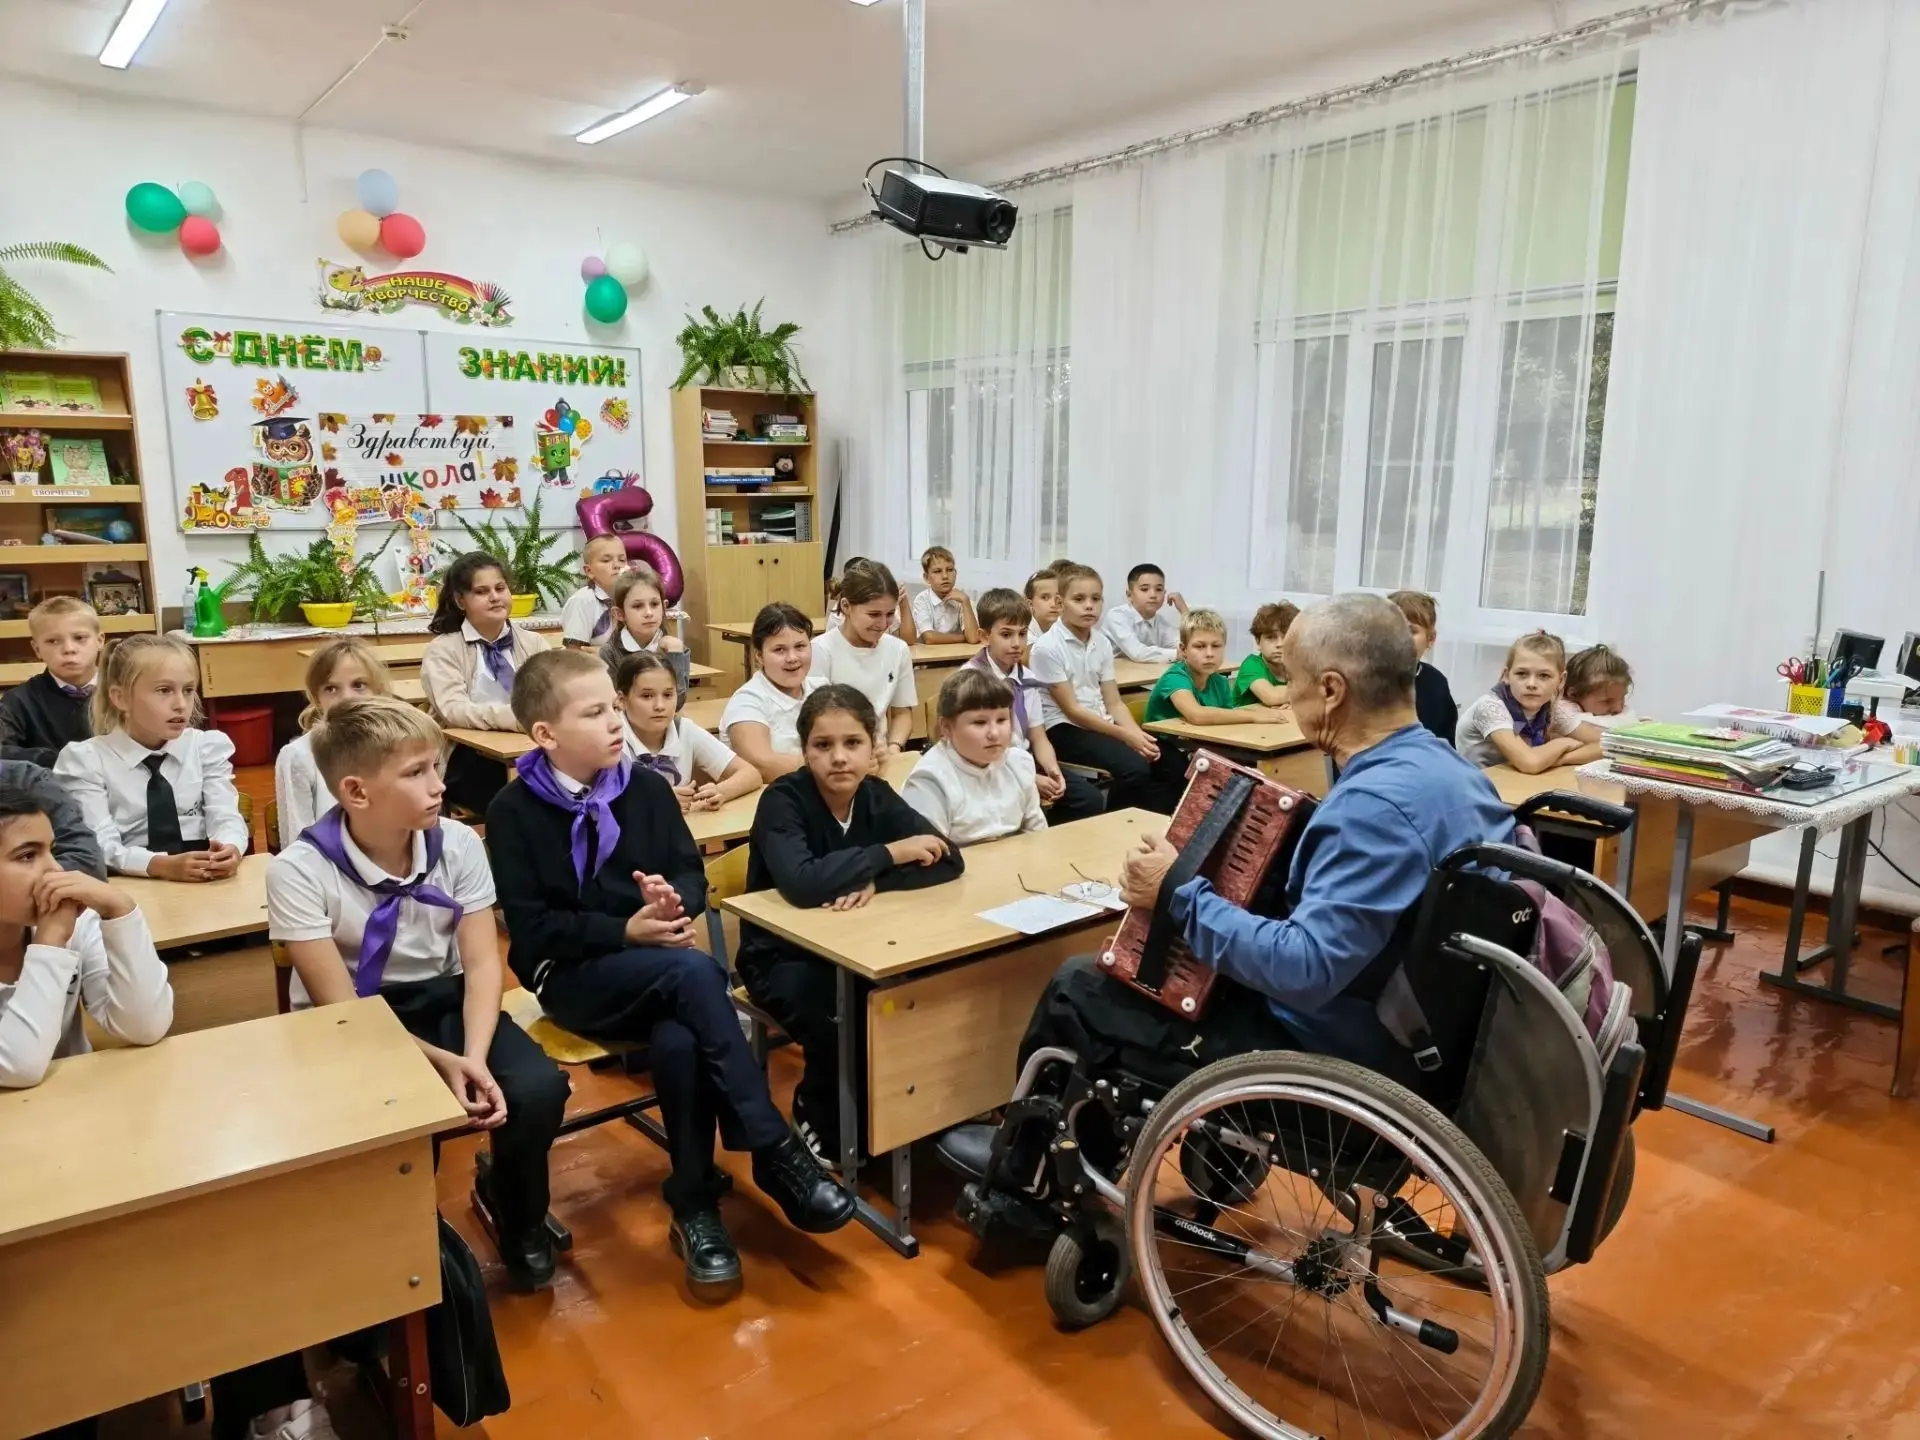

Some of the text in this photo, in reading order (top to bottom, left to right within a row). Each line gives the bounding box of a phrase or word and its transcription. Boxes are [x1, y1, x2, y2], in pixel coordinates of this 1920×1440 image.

[364, 288, 470, 313] ТВОРЧЕСТВО
[388, 276, 448, 291] НАШЕ
[182, 327, 365, 373] С ДНЁМ
[457, 346, 627, 388] ЗНАНИЙ!
[347, 423, 495, 460] Здравствуй,
